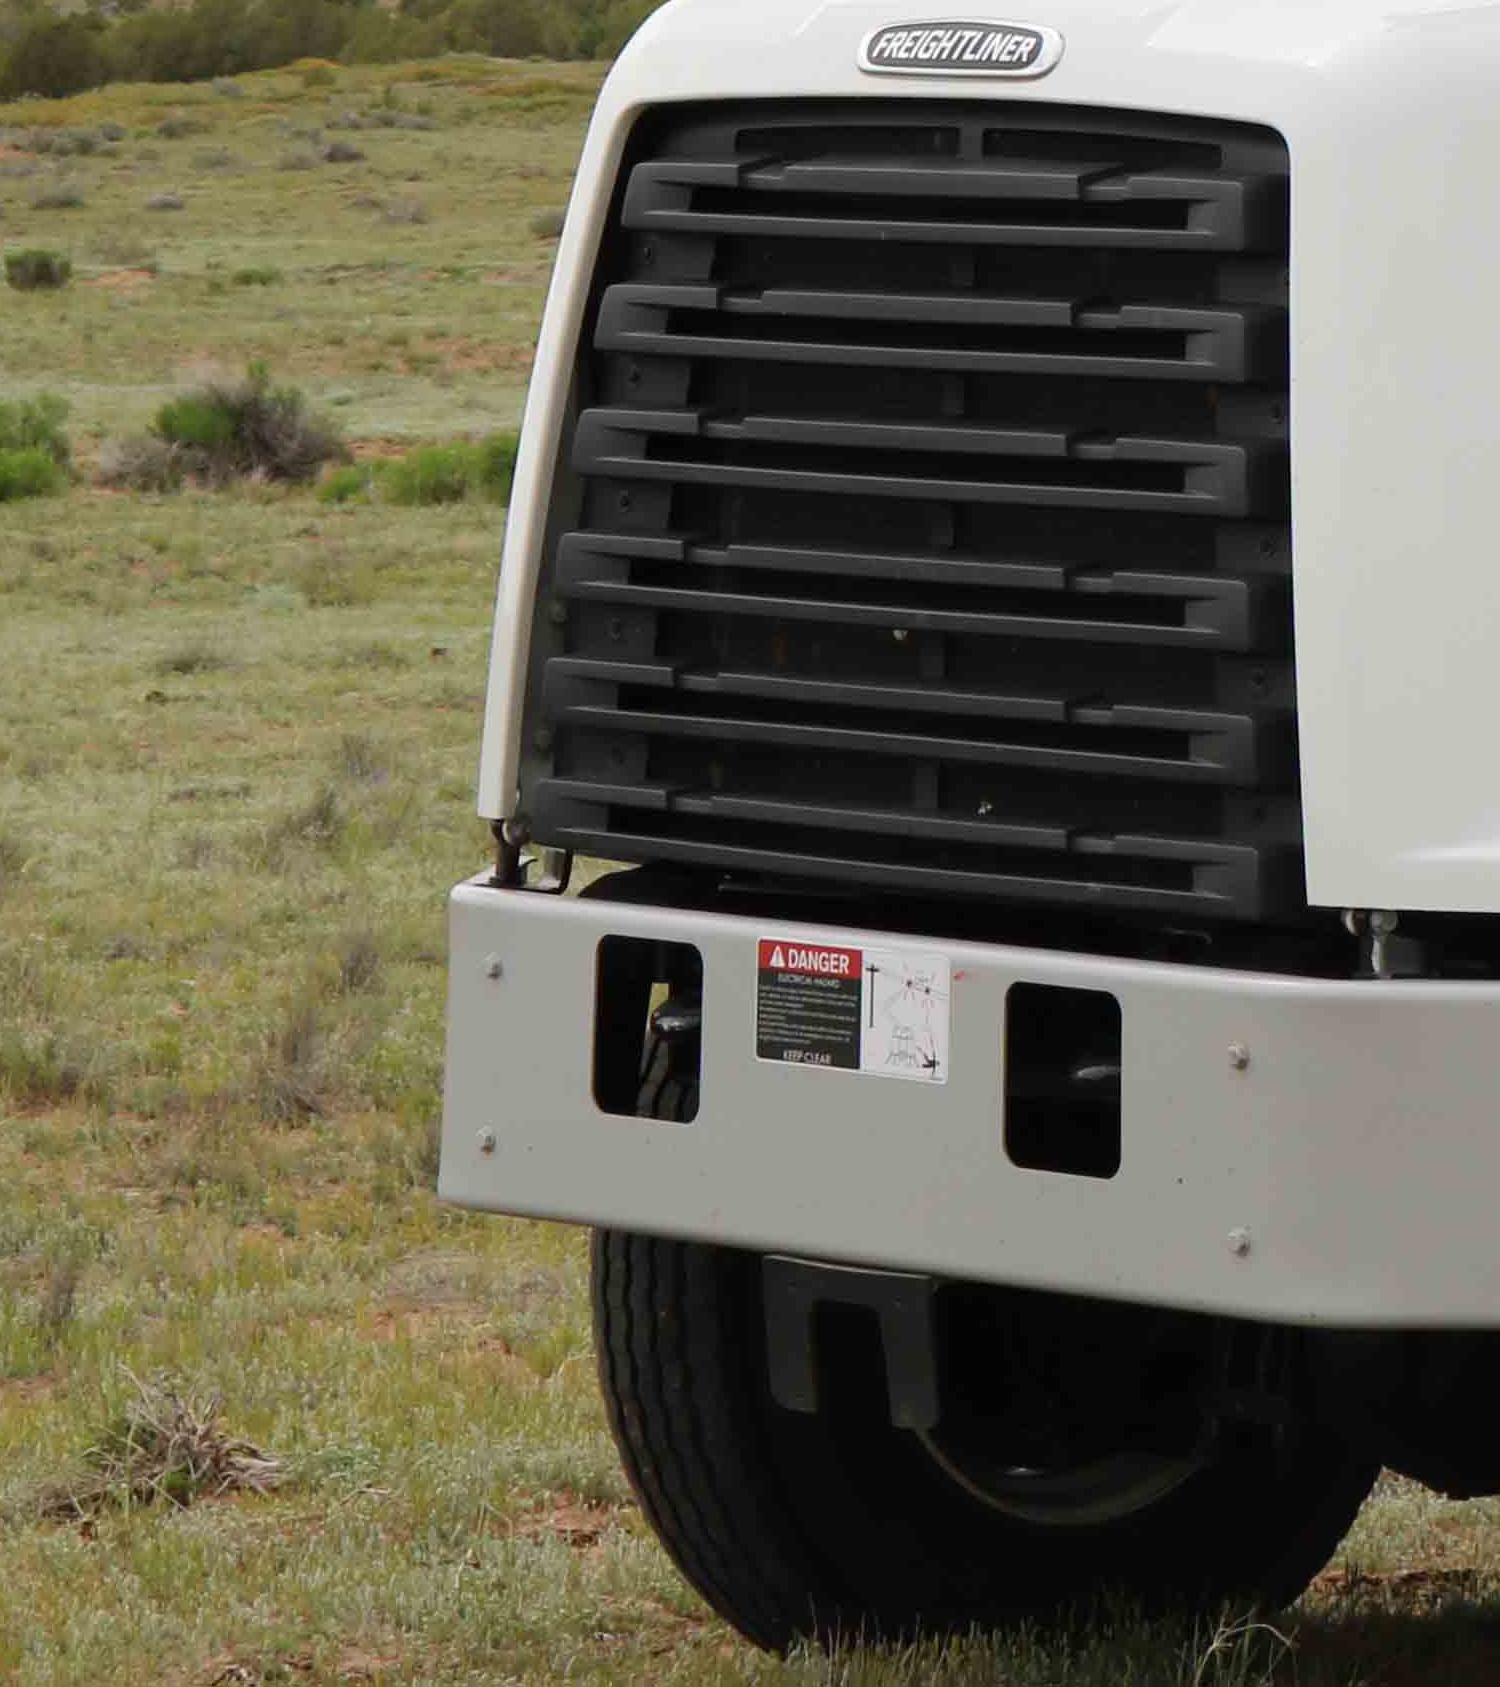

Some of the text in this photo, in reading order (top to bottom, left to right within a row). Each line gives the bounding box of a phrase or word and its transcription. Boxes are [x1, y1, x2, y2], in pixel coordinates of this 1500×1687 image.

[872, 29, 1038, 64] FREIGHTLINER
[787, 948, 850, 975] DANGER
[782, 1049, 804, 1062] KEEP
